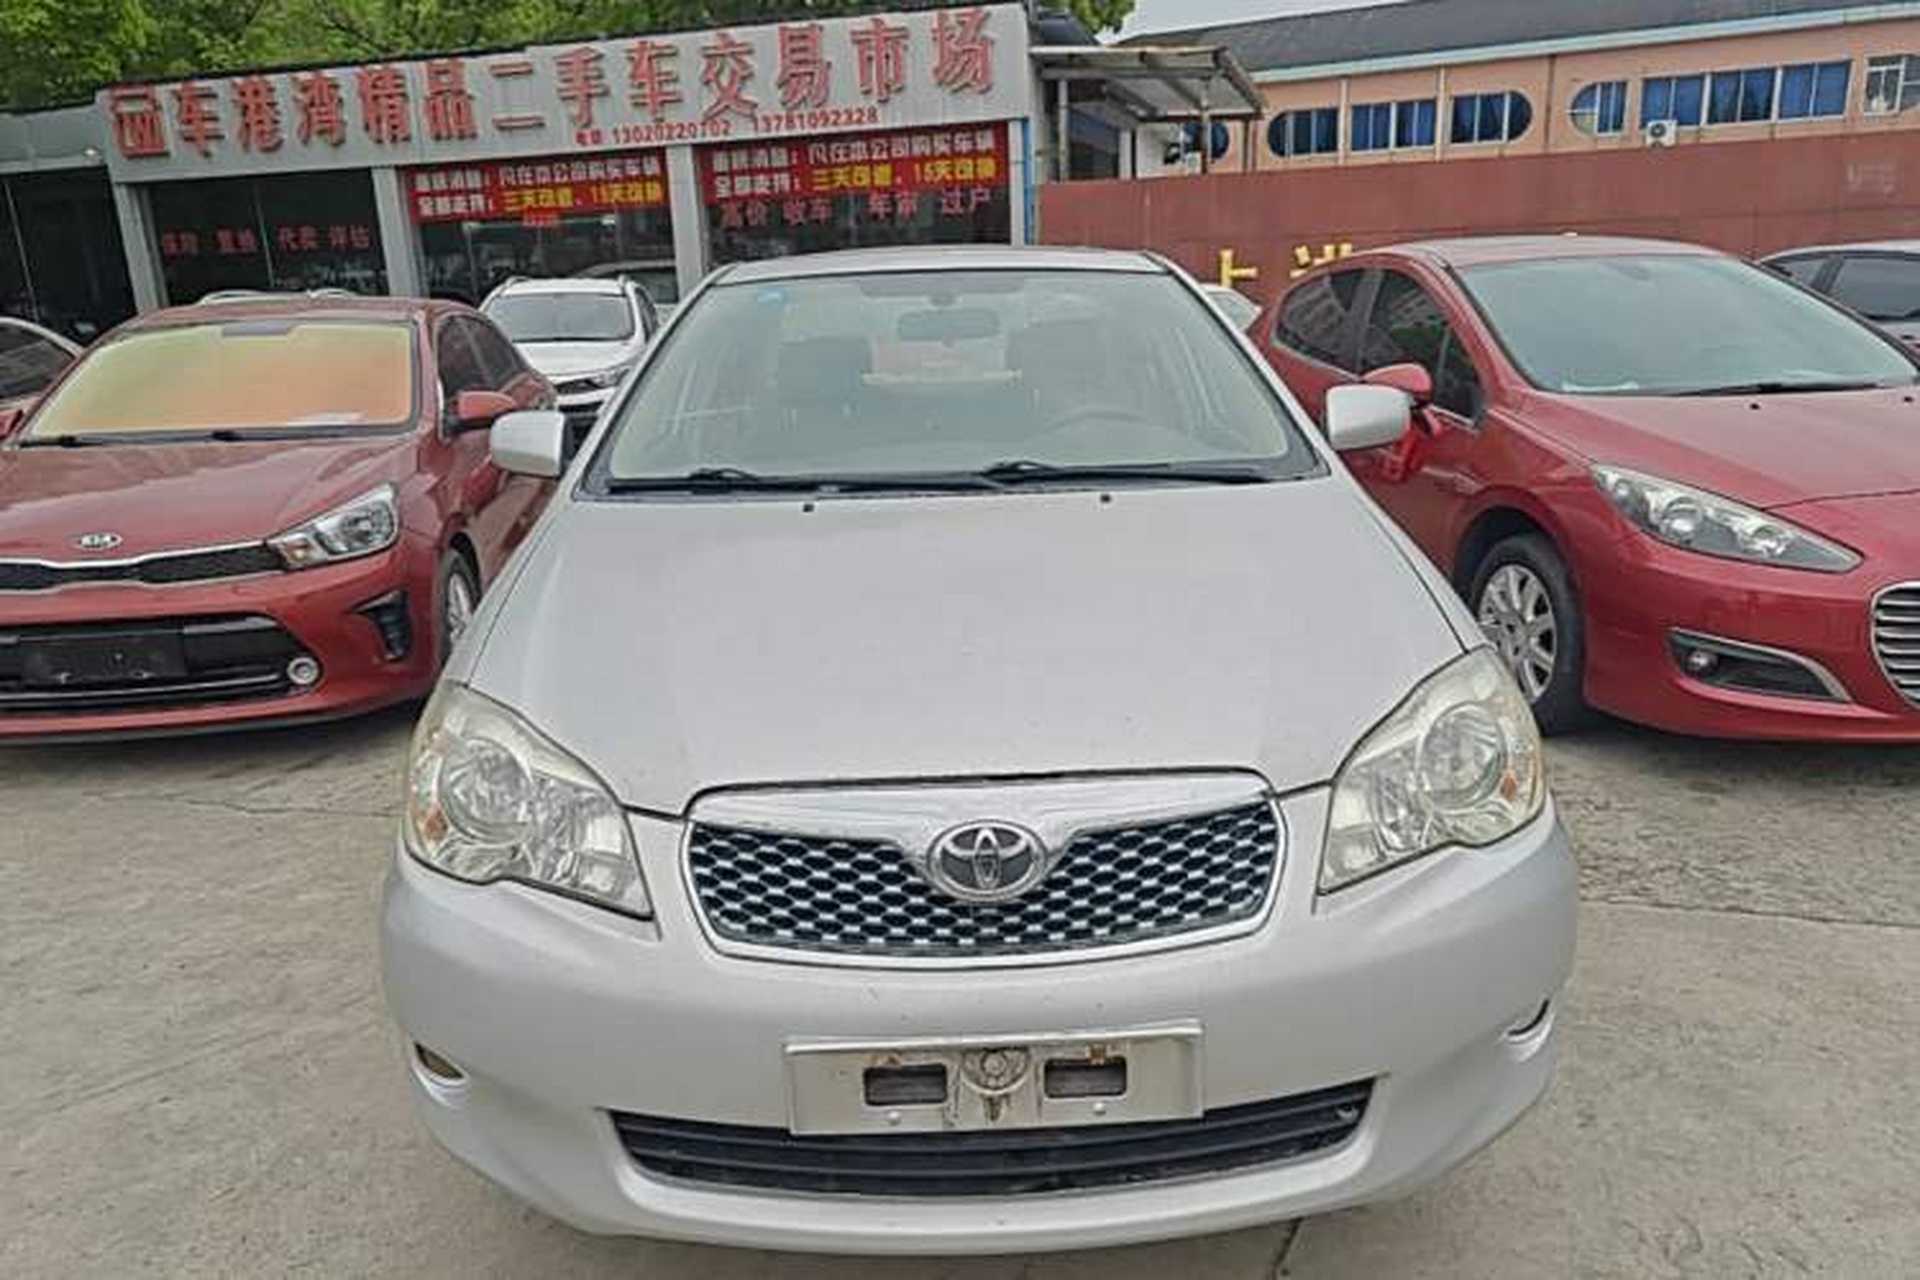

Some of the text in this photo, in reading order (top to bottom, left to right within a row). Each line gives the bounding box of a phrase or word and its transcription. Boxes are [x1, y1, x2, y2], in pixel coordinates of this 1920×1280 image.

[111, 8, 995, 160] 车港湾精品二手车交易市场
[940, 189, 992, 215] 过户
